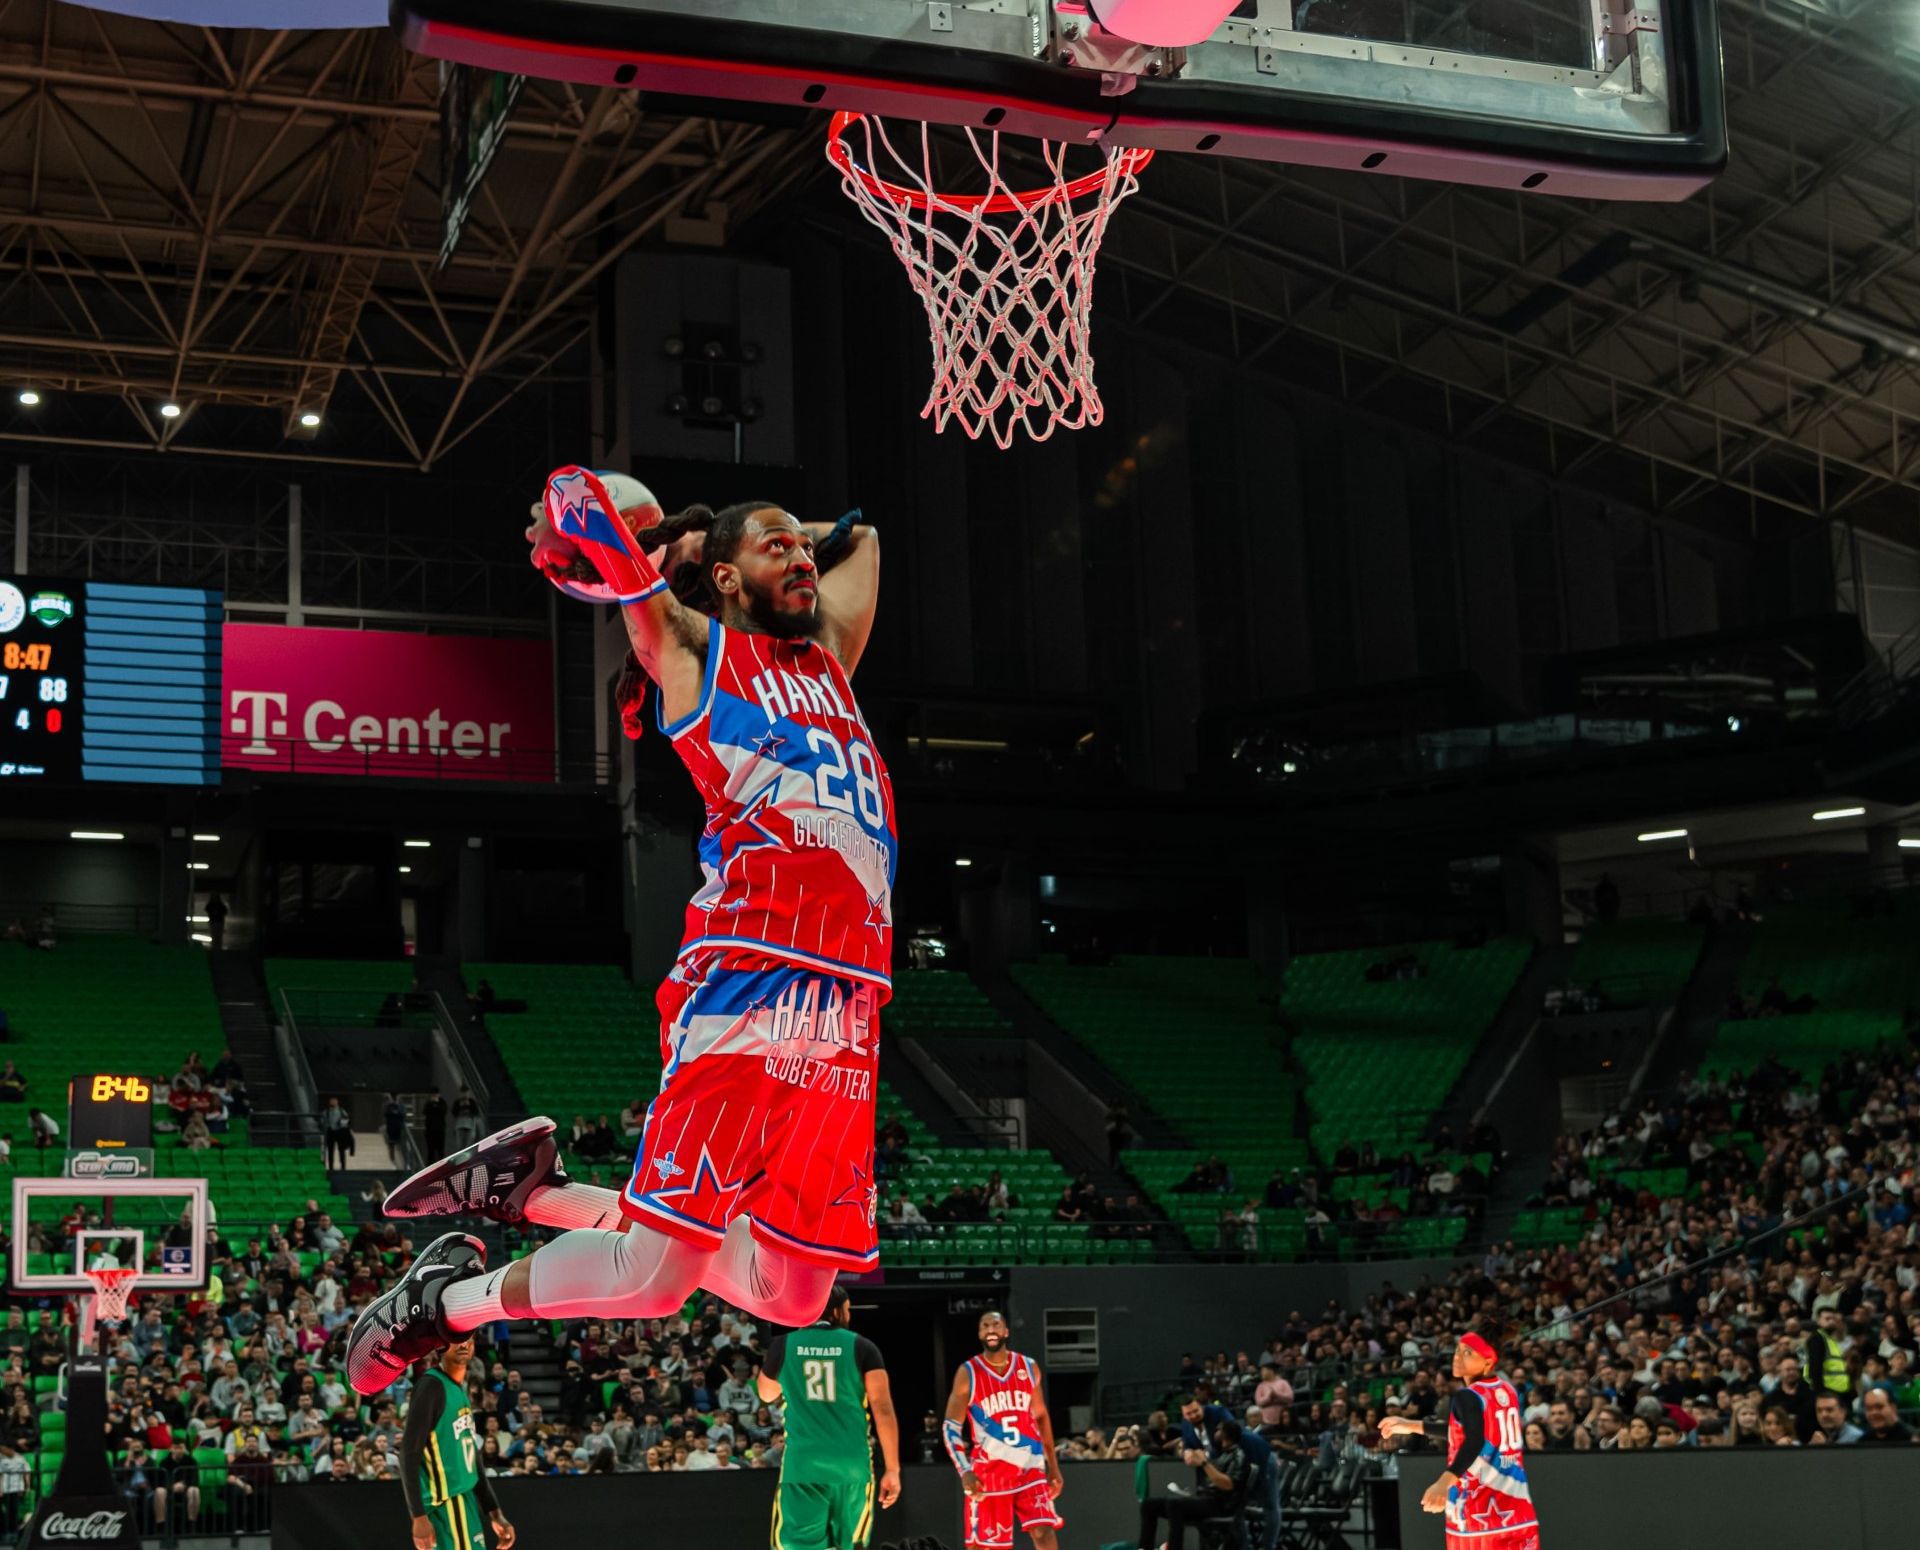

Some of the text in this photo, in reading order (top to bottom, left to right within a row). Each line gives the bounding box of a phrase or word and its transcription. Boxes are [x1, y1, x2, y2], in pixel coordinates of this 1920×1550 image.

[4, 641, 52, 671] 8:47
[40, 677, 67, 702] 88
[752, 667, 870, 736] HARL
[16, 708, 30, 731] 4
[46, 708, 62, 733] 0
[303, 700, 511, 759] Center
[805, 726, 884, 831] 28
[92, 1075, 149, 1102] 8:46
[804, 1360, 835, 1402] 21
[1001, 1415, 1021, 1446] 5
[1495, 1407, 1523, 1452] 10
